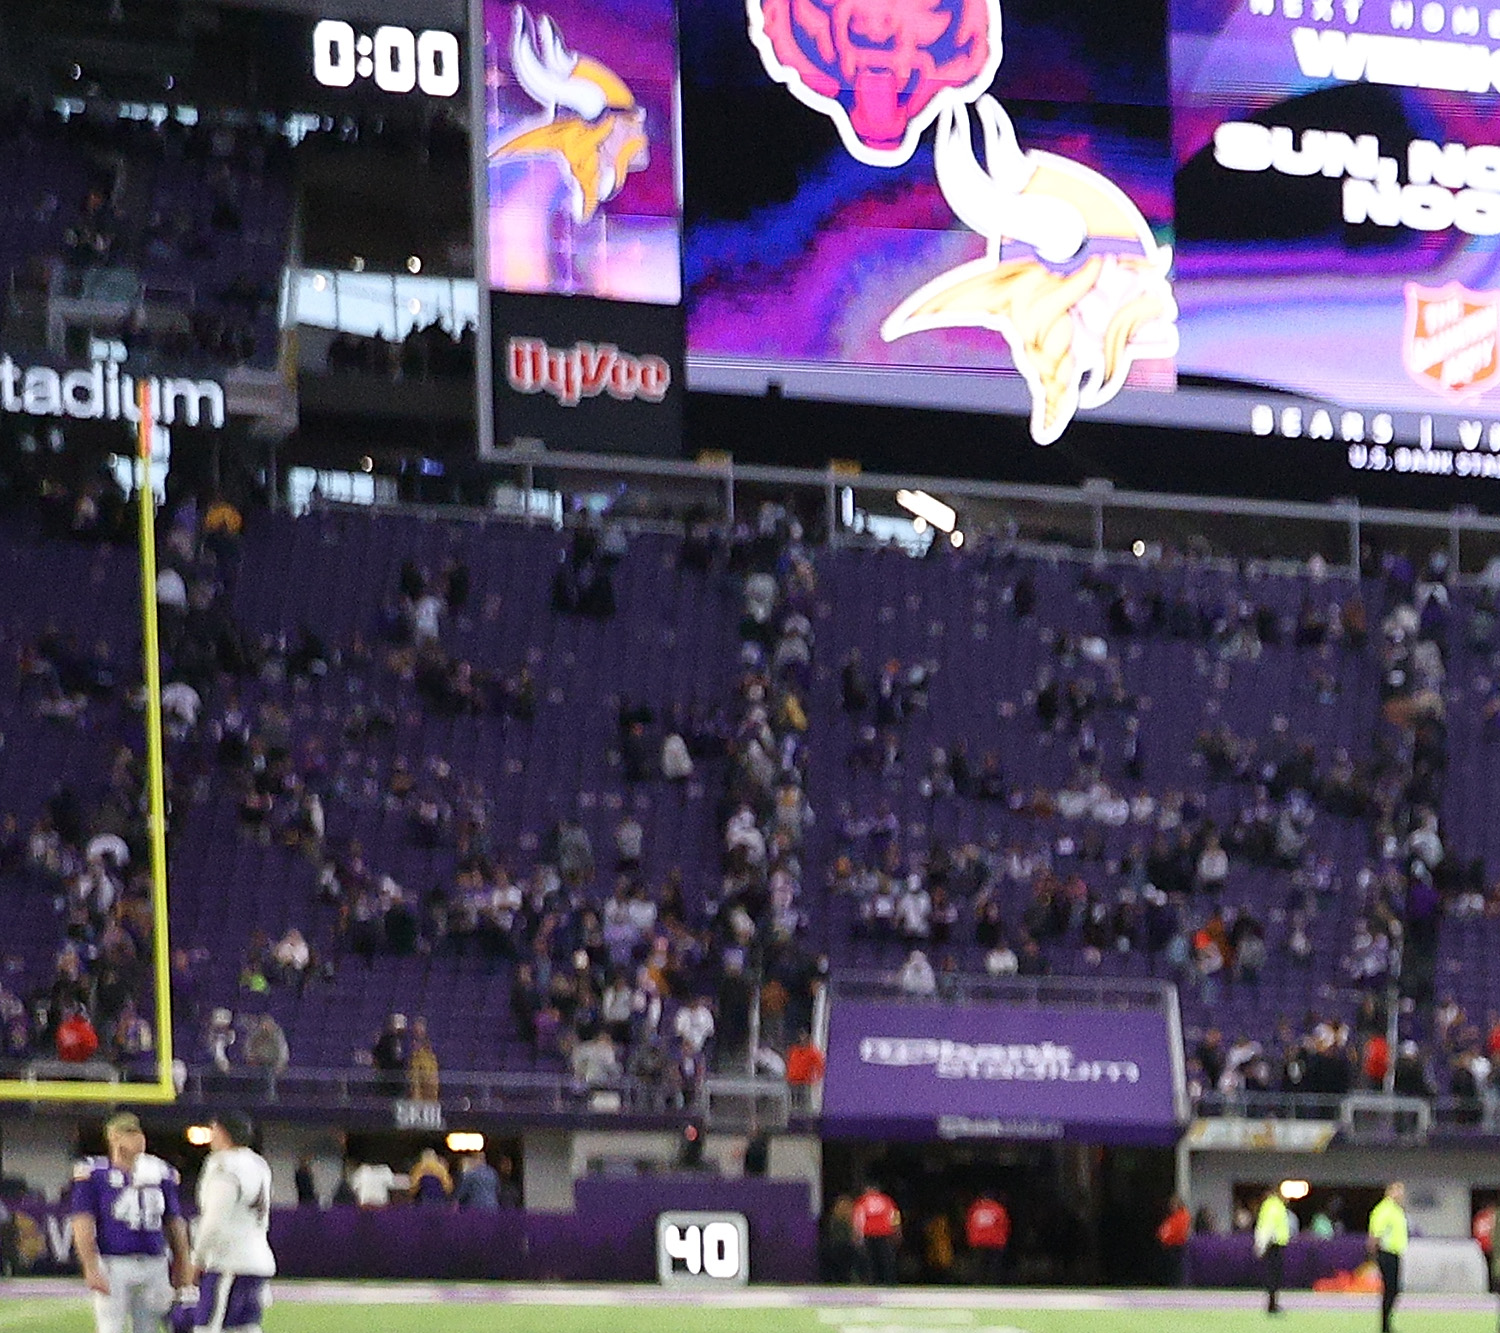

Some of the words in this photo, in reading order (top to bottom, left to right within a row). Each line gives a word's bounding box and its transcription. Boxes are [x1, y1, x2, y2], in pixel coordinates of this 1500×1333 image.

[313, 19, 460, 97] 0:00
[1250, 403, 1394, 444] BEARS
[664, 1221, 741, 1279] 40
